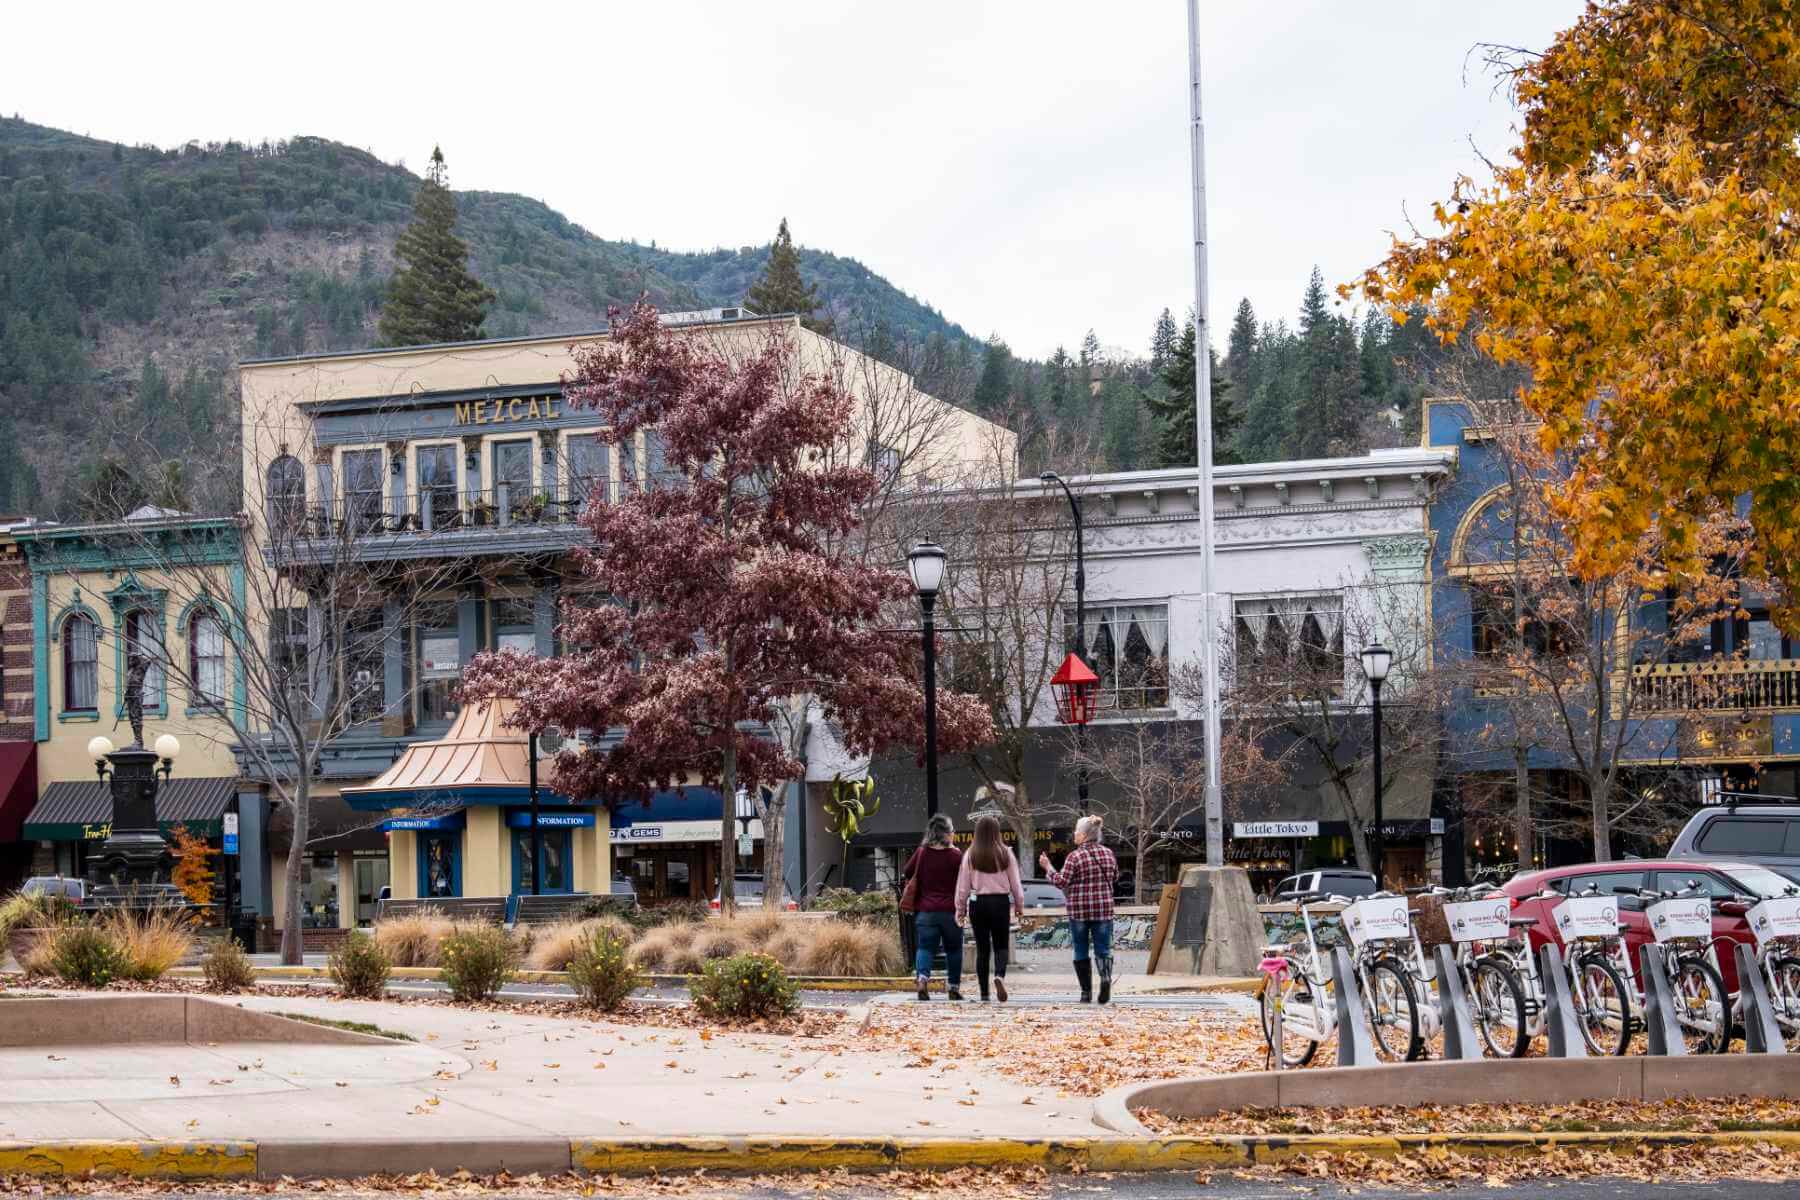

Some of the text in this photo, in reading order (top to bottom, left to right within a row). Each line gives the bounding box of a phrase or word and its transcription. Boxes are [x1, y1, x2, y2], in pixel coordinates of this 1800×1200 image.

[454, 396, 560, 425] MEZCAL
[536, 816, 584, 825] NFORMATION
[633, 828, 660, 837] GEMS
[1240, 822, 1308, 834] Little Tokyo
[1160, 831, 1193, 840] BENTO
